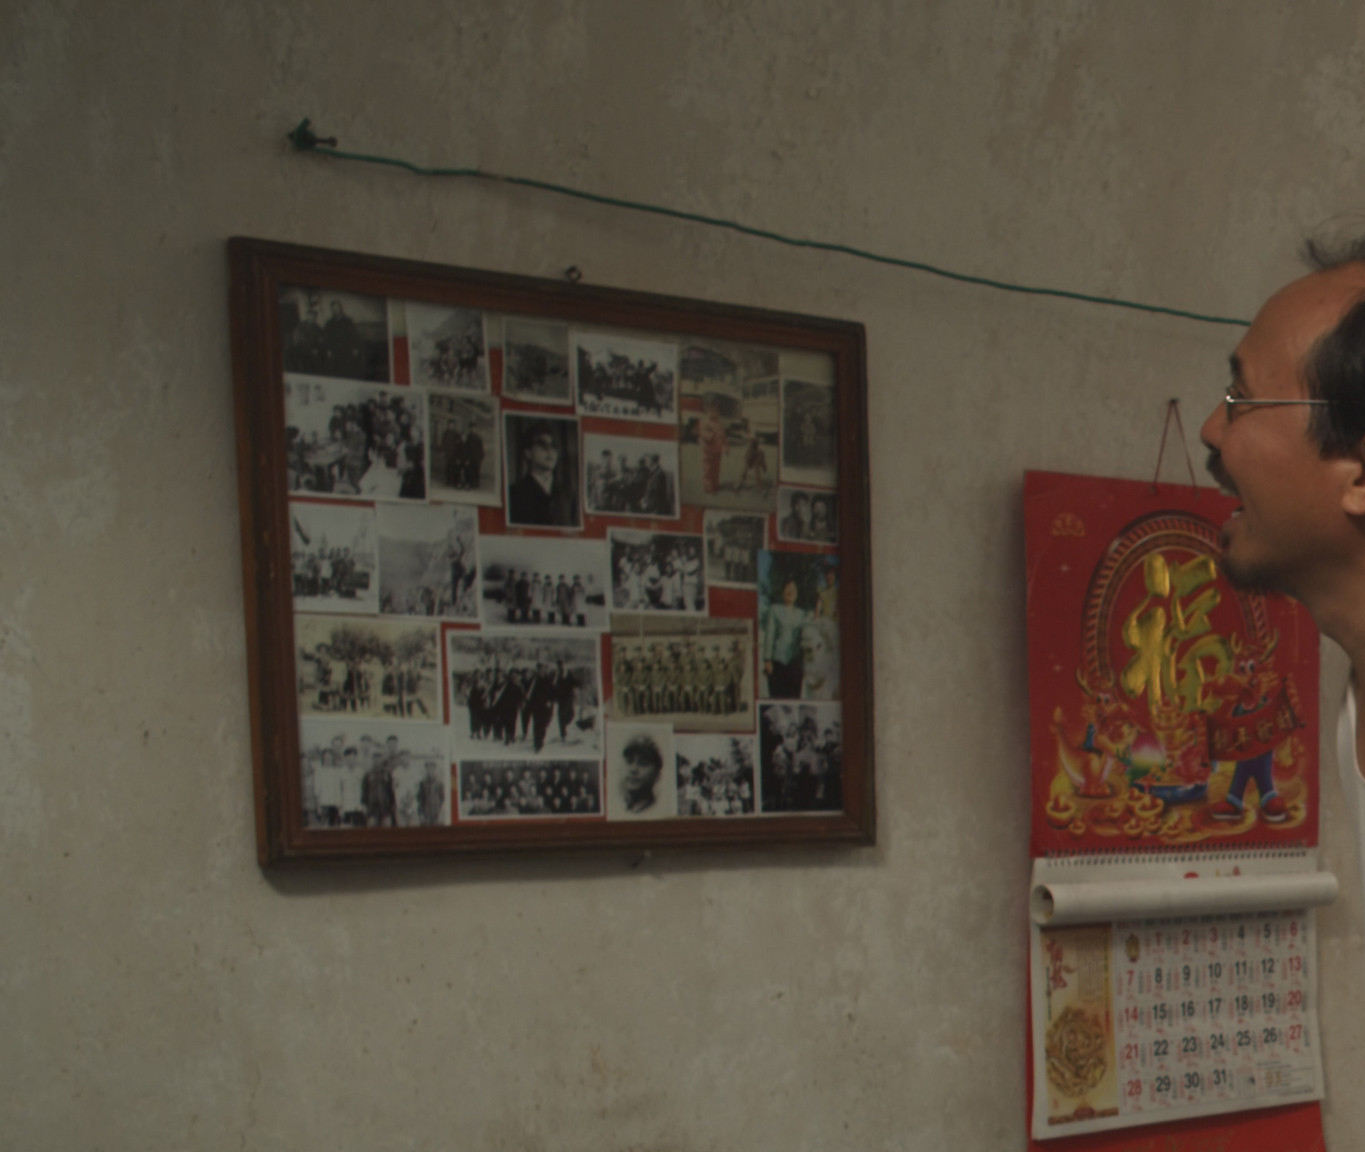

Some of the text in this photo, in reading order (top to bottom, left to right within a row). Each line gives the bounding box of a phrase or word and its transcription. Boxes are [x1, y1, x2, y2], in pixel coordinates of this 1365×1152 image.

[1182, 930, 1189, 944] 2
[1210, 928, 1218, 942] 3
[1238, 925, 1244, 939] 4
[1264, 924, 1271, 938] 5
[1290, 922, 1297, 936] 6
[1127, 957, 1301, 985] 7 8 9 10 11 12 13
[1124, 991, 1301, 1021] 14 15 16 17 18 19 20
[1125, 1025, 1301, 1059] 21 22 23 24 25 26 27
[1128, 1070, 1226, 1095] 28 29 30 31
